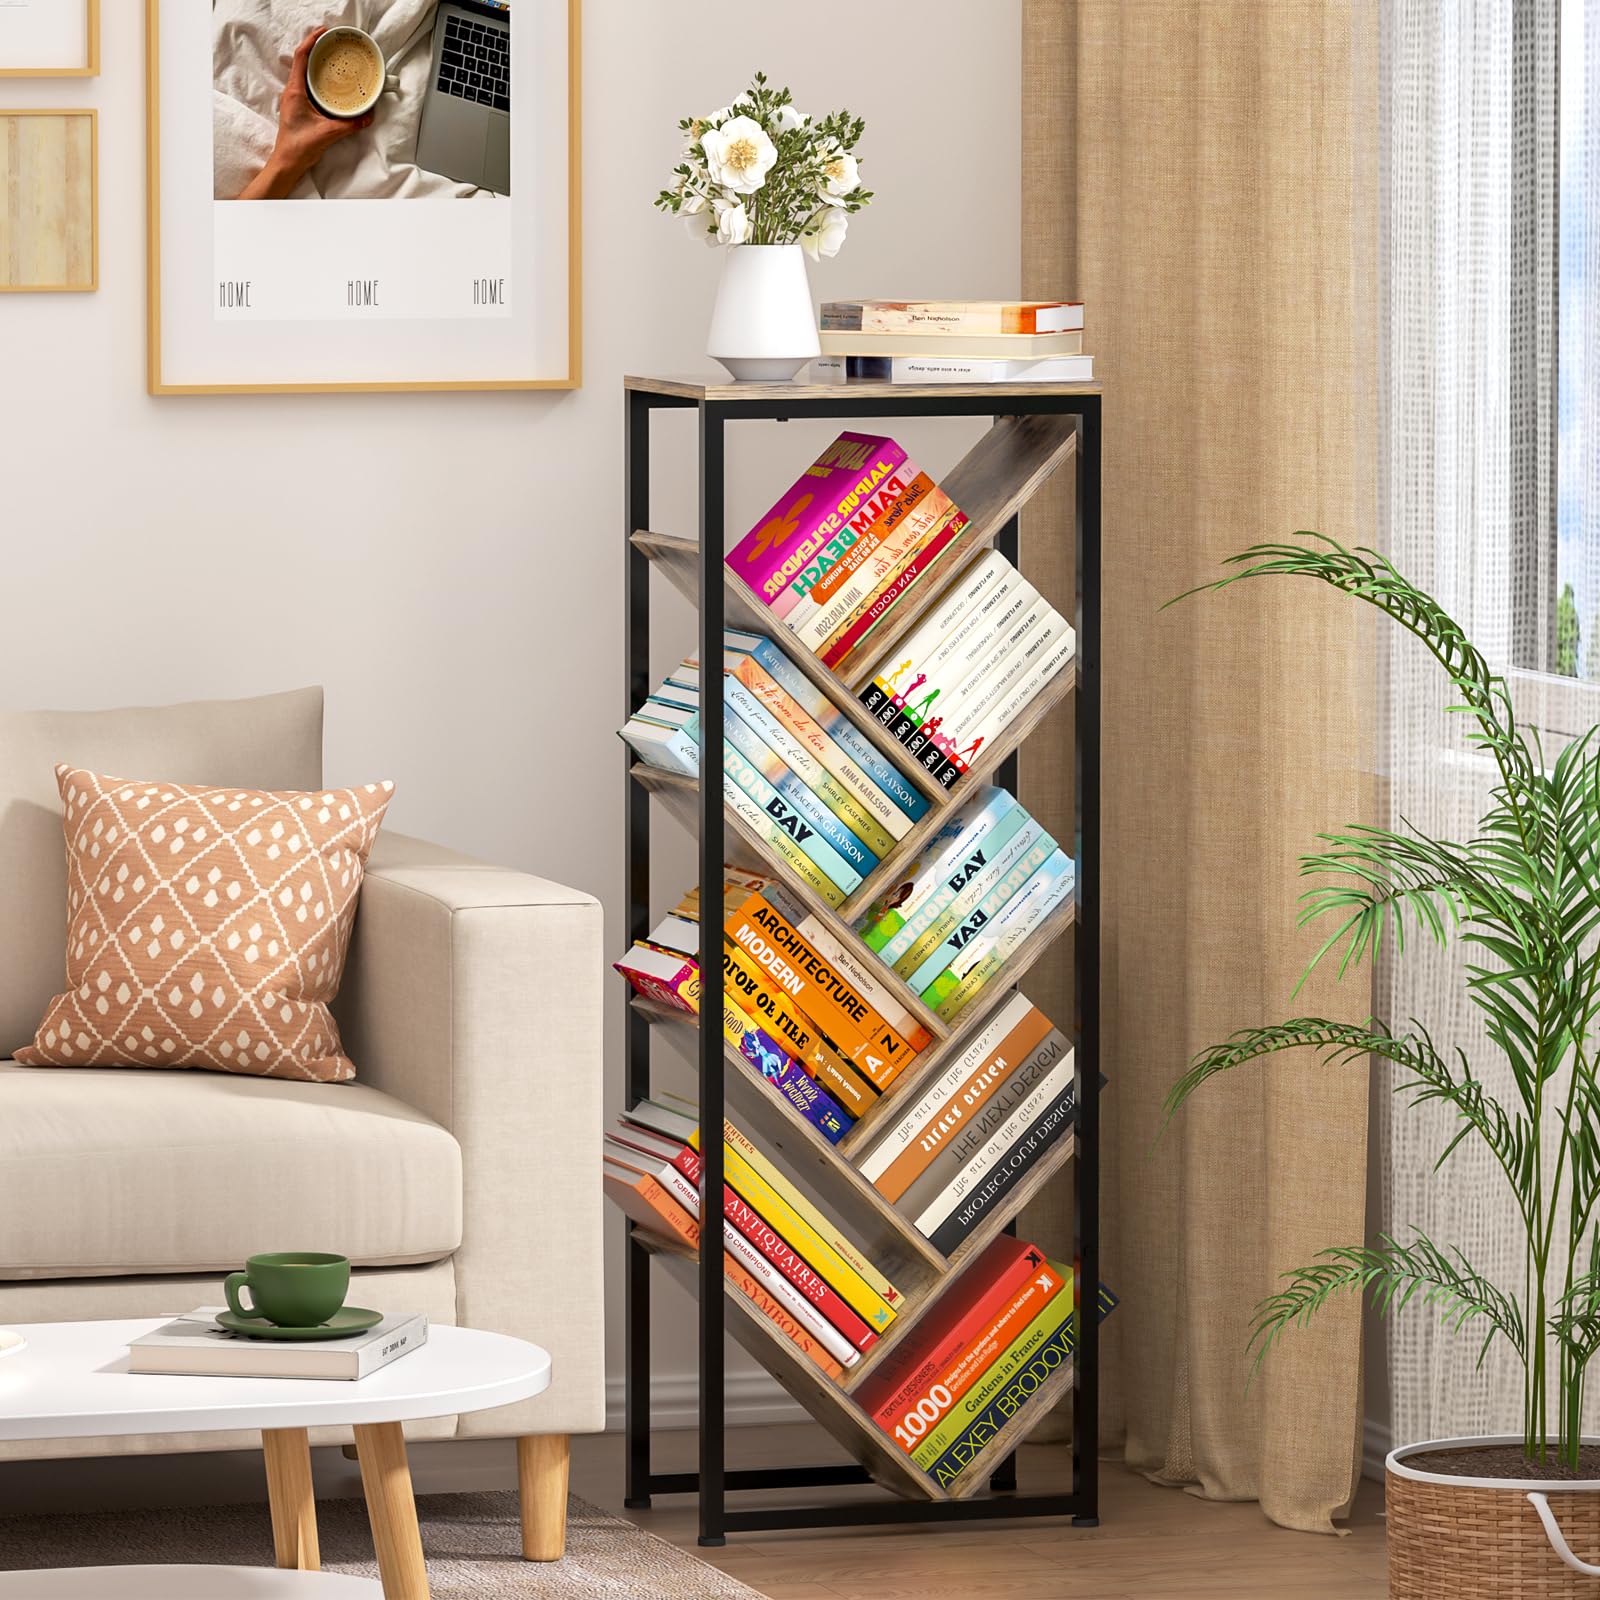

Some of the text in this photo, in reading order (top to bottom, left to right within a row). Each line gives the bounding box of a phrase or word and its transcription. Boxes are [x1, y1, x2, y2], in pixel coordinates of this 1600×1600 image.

[219, 281, 252, 307] HOME
[347, 279, 379, 306] HOME
[473, 278, 505, 305] HOME
[911, 314, 960, 323] Ben Nicholson
[968, 578, 986, 598] FLEMING
[982, 593, 1000, 613] FLEMING
[997, 608, 1015, 627] FLEMING
[1010, 622, 1029, 643] FLEMING
[1025, 637, 1044, 657] FLEMING
[1042, 655, 1060, 675] FLEMING
[863, 692, 881, 709] 007
[793, 716, 809, 731] du
[879, 706, 895, 724] 007
[894, 721, 910, 739] 007
[908, 736, 924, 753] 007
[843, 732, 861, 753] PLACE
[862, 752, 875, 766] FOR
[879, 770, 915, 808] GRAYSON
[923, 751, 939, 768] 007
[940, 768, 955, 786] 007
[840, 766, 891, 817] ANNA KARLSSON
[823, 782, 871, 832] SHIRLEY CASEMIER
[766, 797, 813, 843] BAY
[791, 788, 810, 808] PLACE
[810, 807, 823, 822] FOR
[828, 825, 864, 863] GRAYSON
[772, 836, 795, 858] SHIRLEY
[794, 859, 821, 887] CASEMIER
[890, 886, 955, 955] BYRON
[948, 849, 986, 893] BAY
[936, 916, 955, 937] SHIRLEY
[736, 924, 805, 995] MODERN
[912, 936, 935, 961] CASEMIER
[752, 908, 868, 1023] ARCHITECTURE
[838, 954, 873, 992] Ben Nicholson
[880, 1034, 899, 1054] Z
[895, 1048, 910, 1064] TASCHEN
[865, 1054, 883, 1073] A
[876, 1067, 893, 1084] TASCHEN
[728, 1200, 827, 1296] ANTIQUAIRES
[733, 1239, 770, 1277] CHAMPIONS
[739, 1279, 813, 1353] SYMBOLS
[965, 1330, 1043, 1412] Gardens in France
[881, 1394, 905, 1418] TEXTILE
[903, 1361, 935, 1396] DESIGNERS
[896, 1385, 952, 1448] 1000
[936, 1411, 998, 1488] ALEXEY
